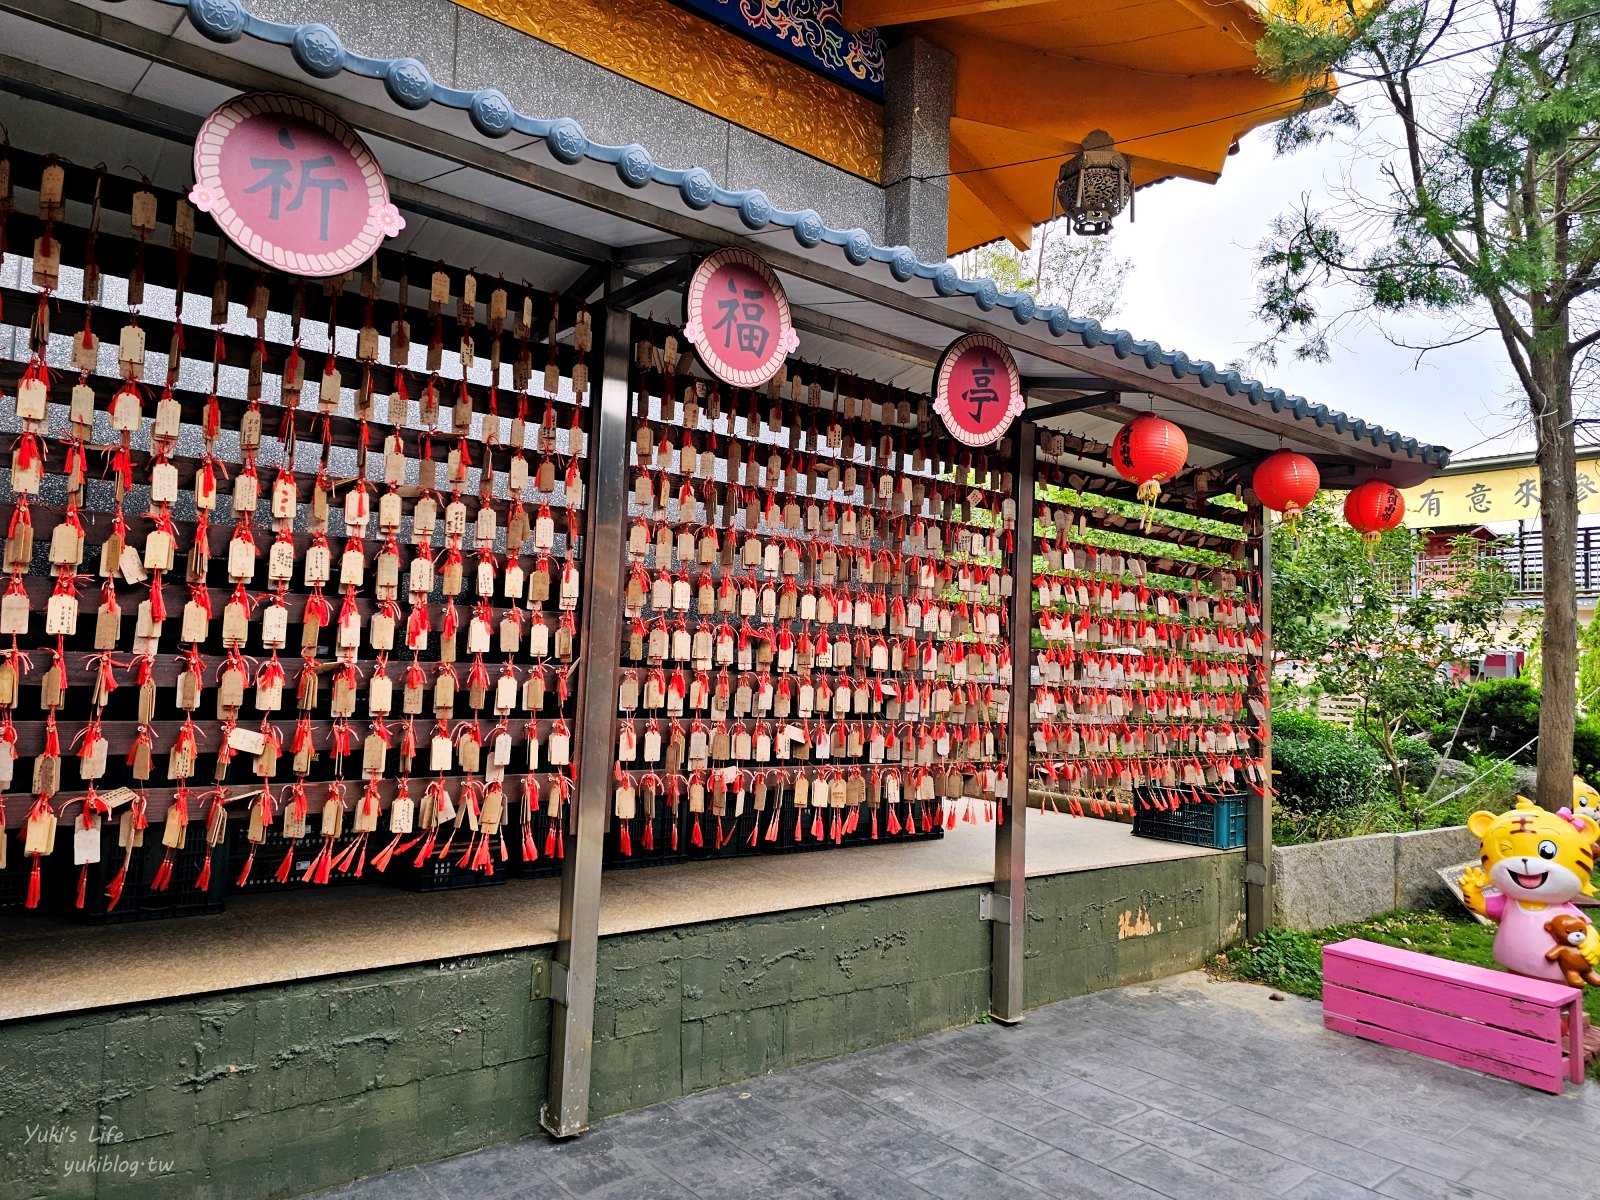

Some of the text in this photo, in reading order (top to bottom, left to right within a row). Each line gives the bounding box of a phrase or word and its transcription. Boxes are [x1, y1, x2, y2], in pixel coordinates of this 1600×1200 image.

[243, 127, 349, 242] 祈
[713, 278, 771, 359] 福
[961, 356, 999, 424] 亭
